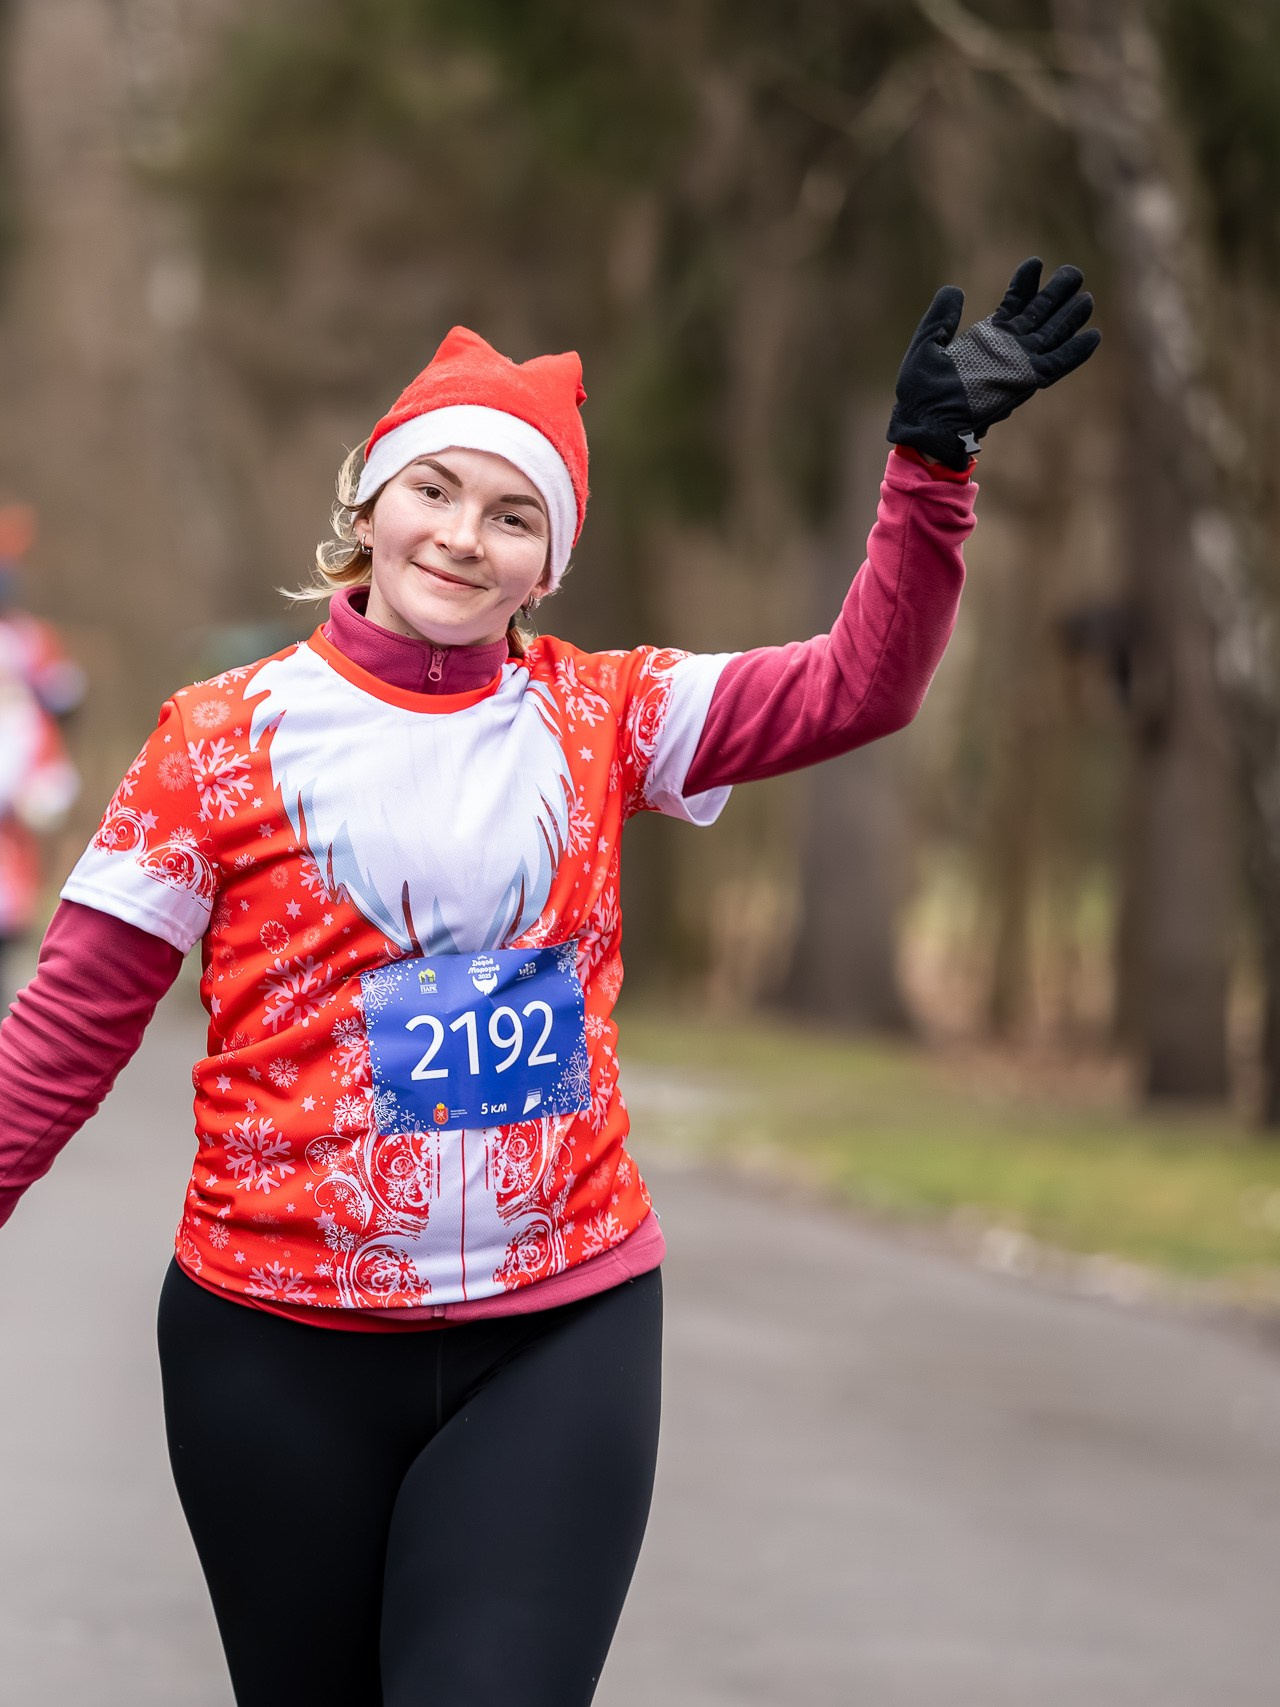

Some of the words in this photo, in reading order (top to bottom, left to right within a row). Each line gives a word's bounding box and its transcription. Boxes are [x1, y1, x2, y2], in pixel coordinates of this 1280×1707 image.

[405, 1000, 557, 1081] 2192
[480, 1103, 488, 1115] 5
[491, 1103, 507, 1114] км
